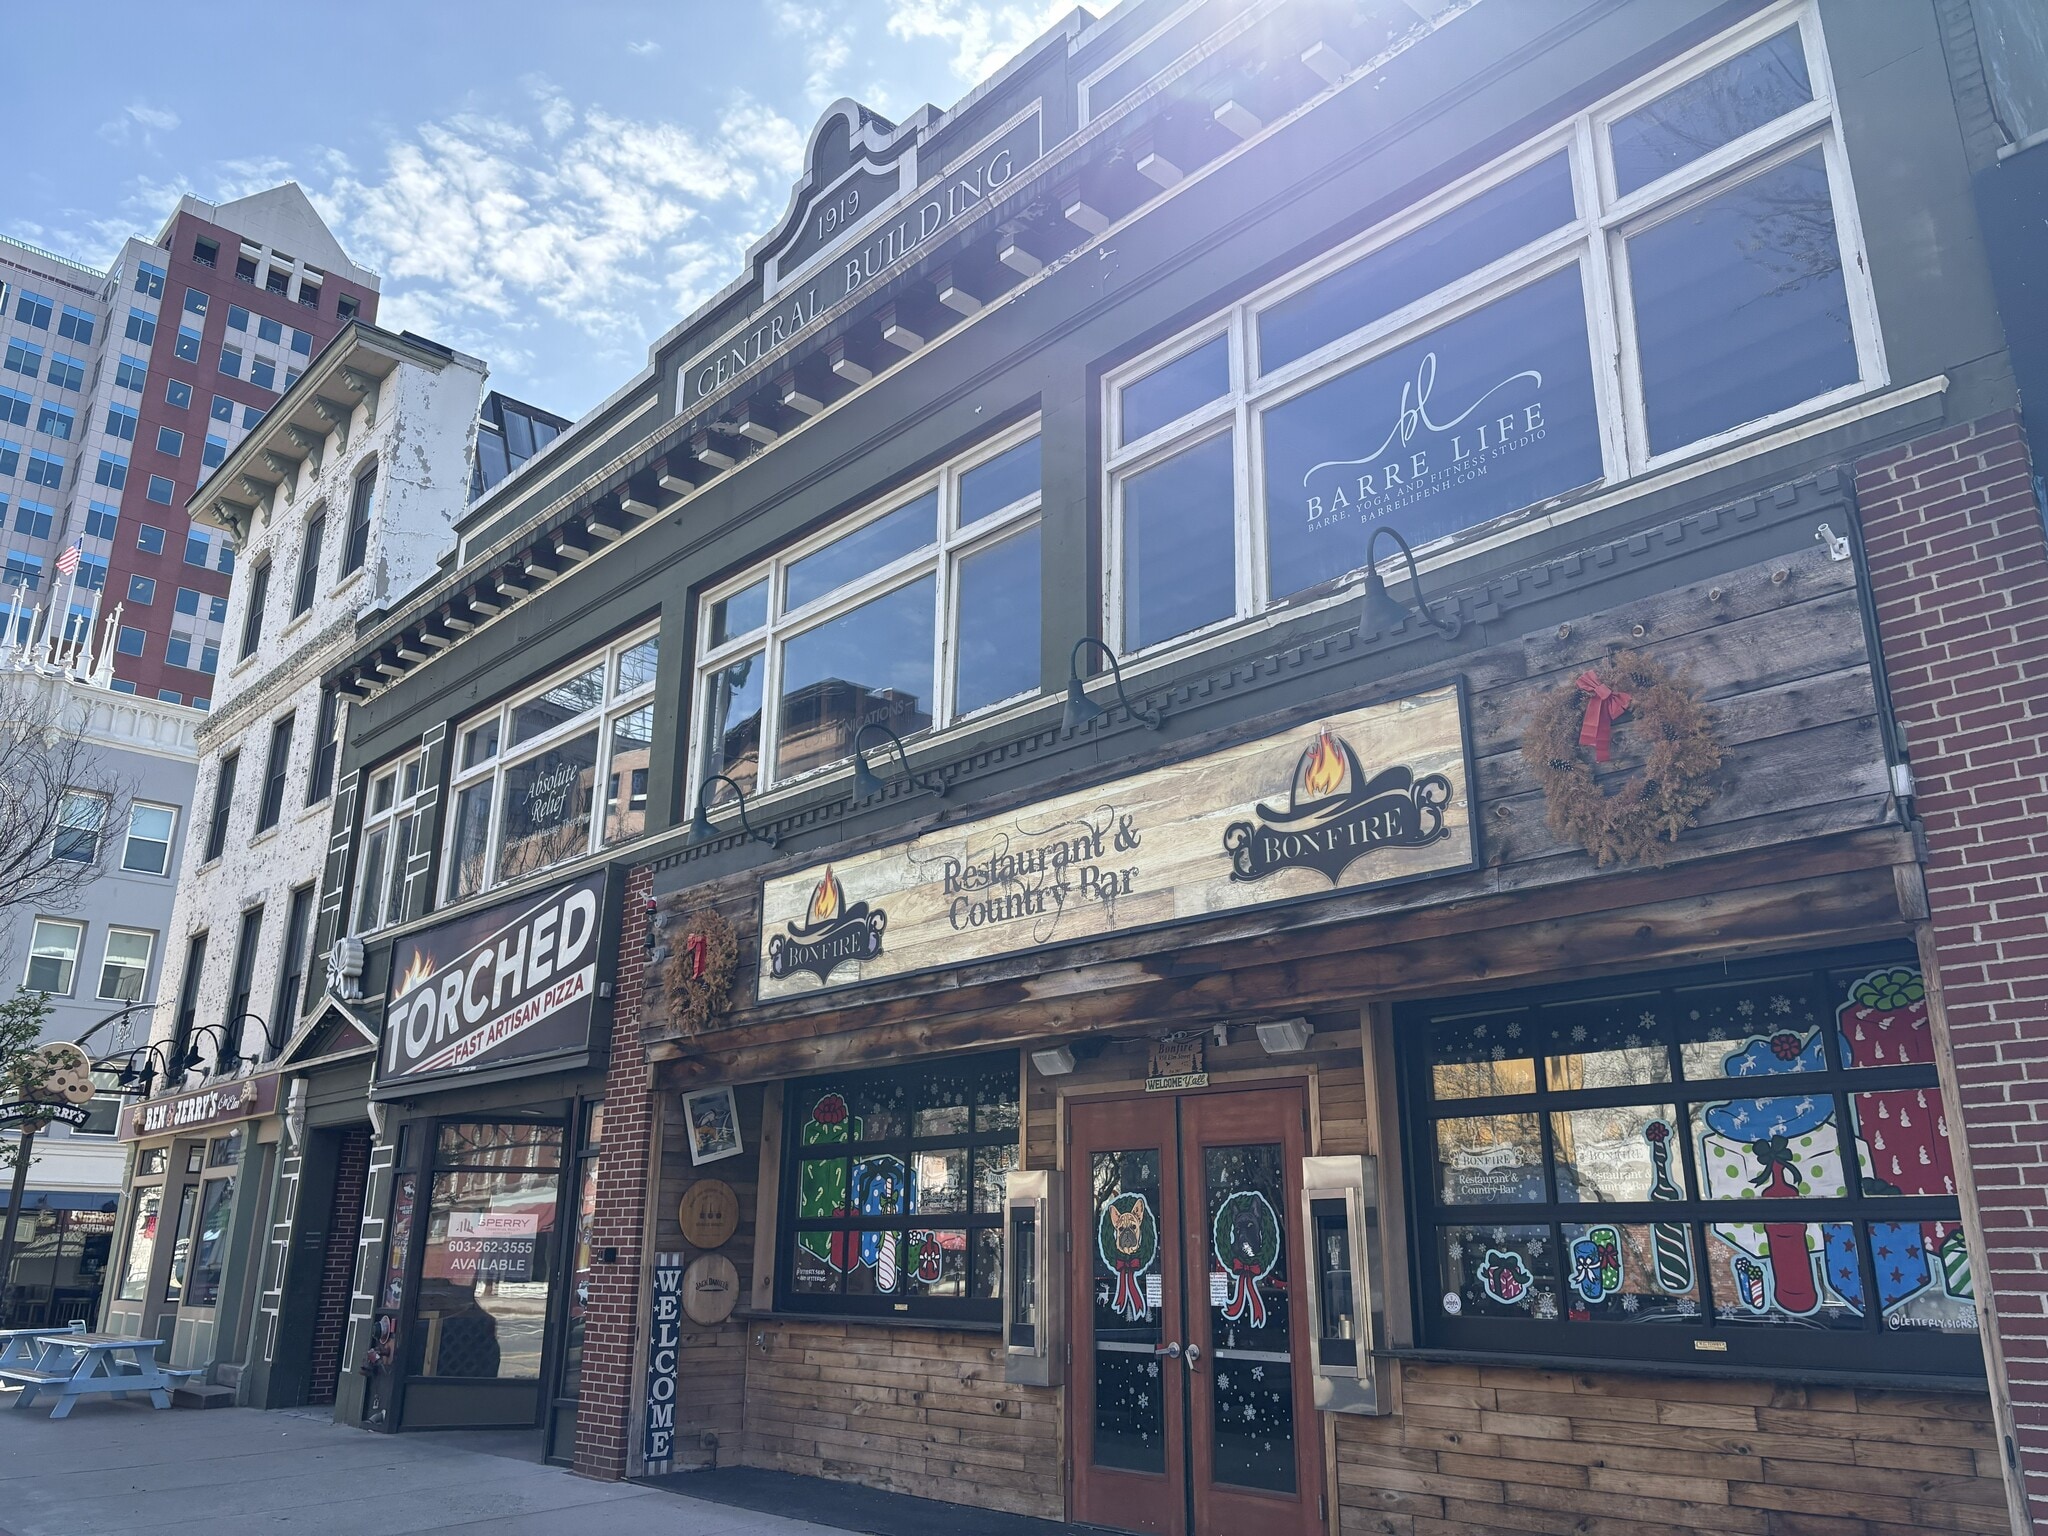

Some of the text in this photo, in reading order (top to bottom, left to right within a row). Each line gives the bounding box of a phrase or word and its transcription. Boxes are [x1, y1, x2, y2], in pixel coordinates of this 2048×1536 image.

[818, 190, 859, 241] 1919
[697, 150, 1013, 397] CENTRAL BUILDING
[1306, 403, 1545, 522] BARRE LIFE
[1308, 429, 1546, 533] BARRE, YOGA AND FITNESS STUDIO
[1361, 466, 1488, 524] BARRELIFENH.COM
[531, 783, 570, 822] Relief
[938, 814, 1142, 896] Restaurant &
[1263, 807, 1403, 864] BONFIRE
[948, 864, 1140, 943] Country Bar
[788, 931, 861, 968] BONFIRE
[388, 889, 596, 1073] TORCHED
[454, 973, 584, 1064] FAST ARTISAN PIZZA
[1159, 1043, 1193, 1055] Bonfire
[1147, 1074, 1206, 1090] WELCOME Y'all
[37, 1104, 86, 1123] JRRY'S
[144, 1105, 167, 1131] BEN
[174, 1091, 218, 1126] JERRY'S
[1459, 1173, 1519, 1184] Restaurant &
[1463, 1154, 1511, 1166] BONFIRE
[1586, 1169, 1641, 1180] Restaurant
[1461, 1185, 1517, 1199] Country Bar
[478, 1219, 530, 1227] SPERRY
[448, 1240, 532, 1254] 603-262-3555
[450, 1258, 525, 1271] AVAILABLE
[651, 1270, 681, 1458] WELCOME
